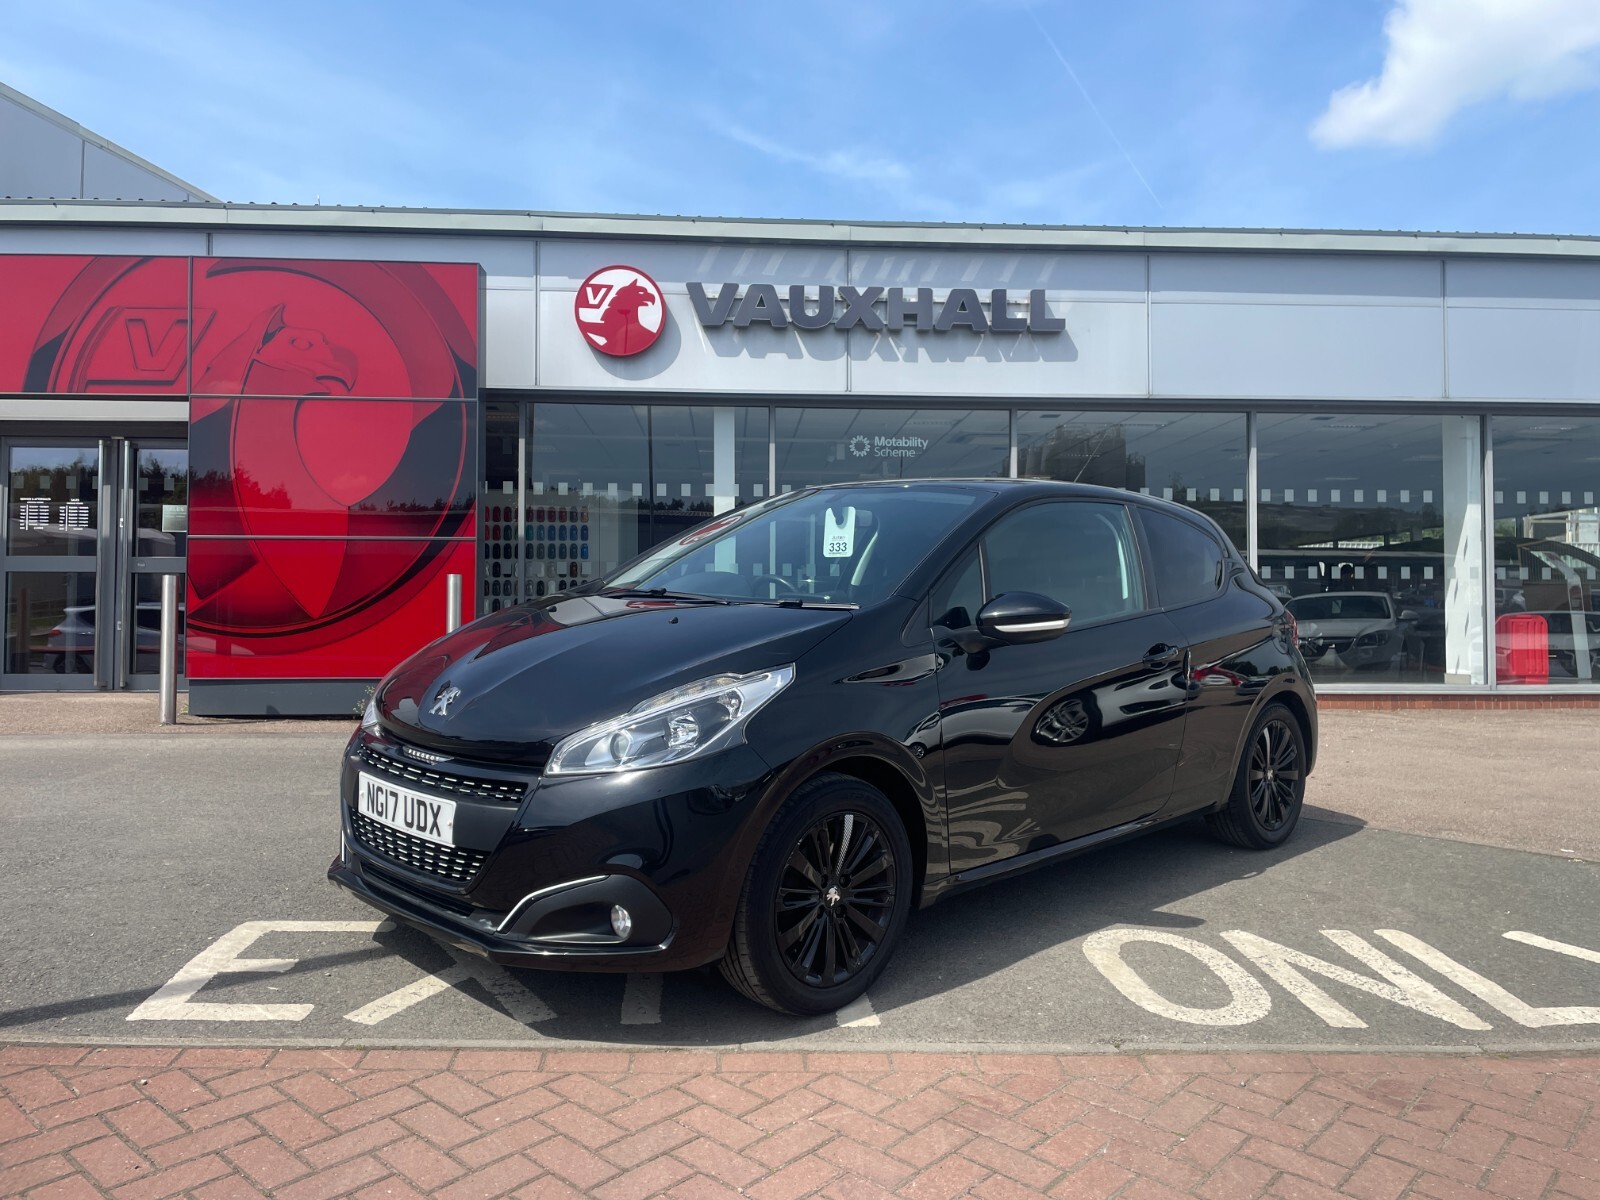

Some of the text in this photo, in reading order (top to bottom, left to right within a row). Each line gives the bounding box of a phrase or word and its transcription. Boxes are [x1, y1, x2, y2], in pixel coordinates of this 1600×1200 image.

[686, 282, 1066, 333] VAUXHALL
[874, 435, 929, 450] Motability
[874, 446, 916, 458] Scheme
[829, 542, 848, 553] 333
[407, 748, 440, 762] PEUGEOT
[366, 781, 442, 838] NG17 UDX
